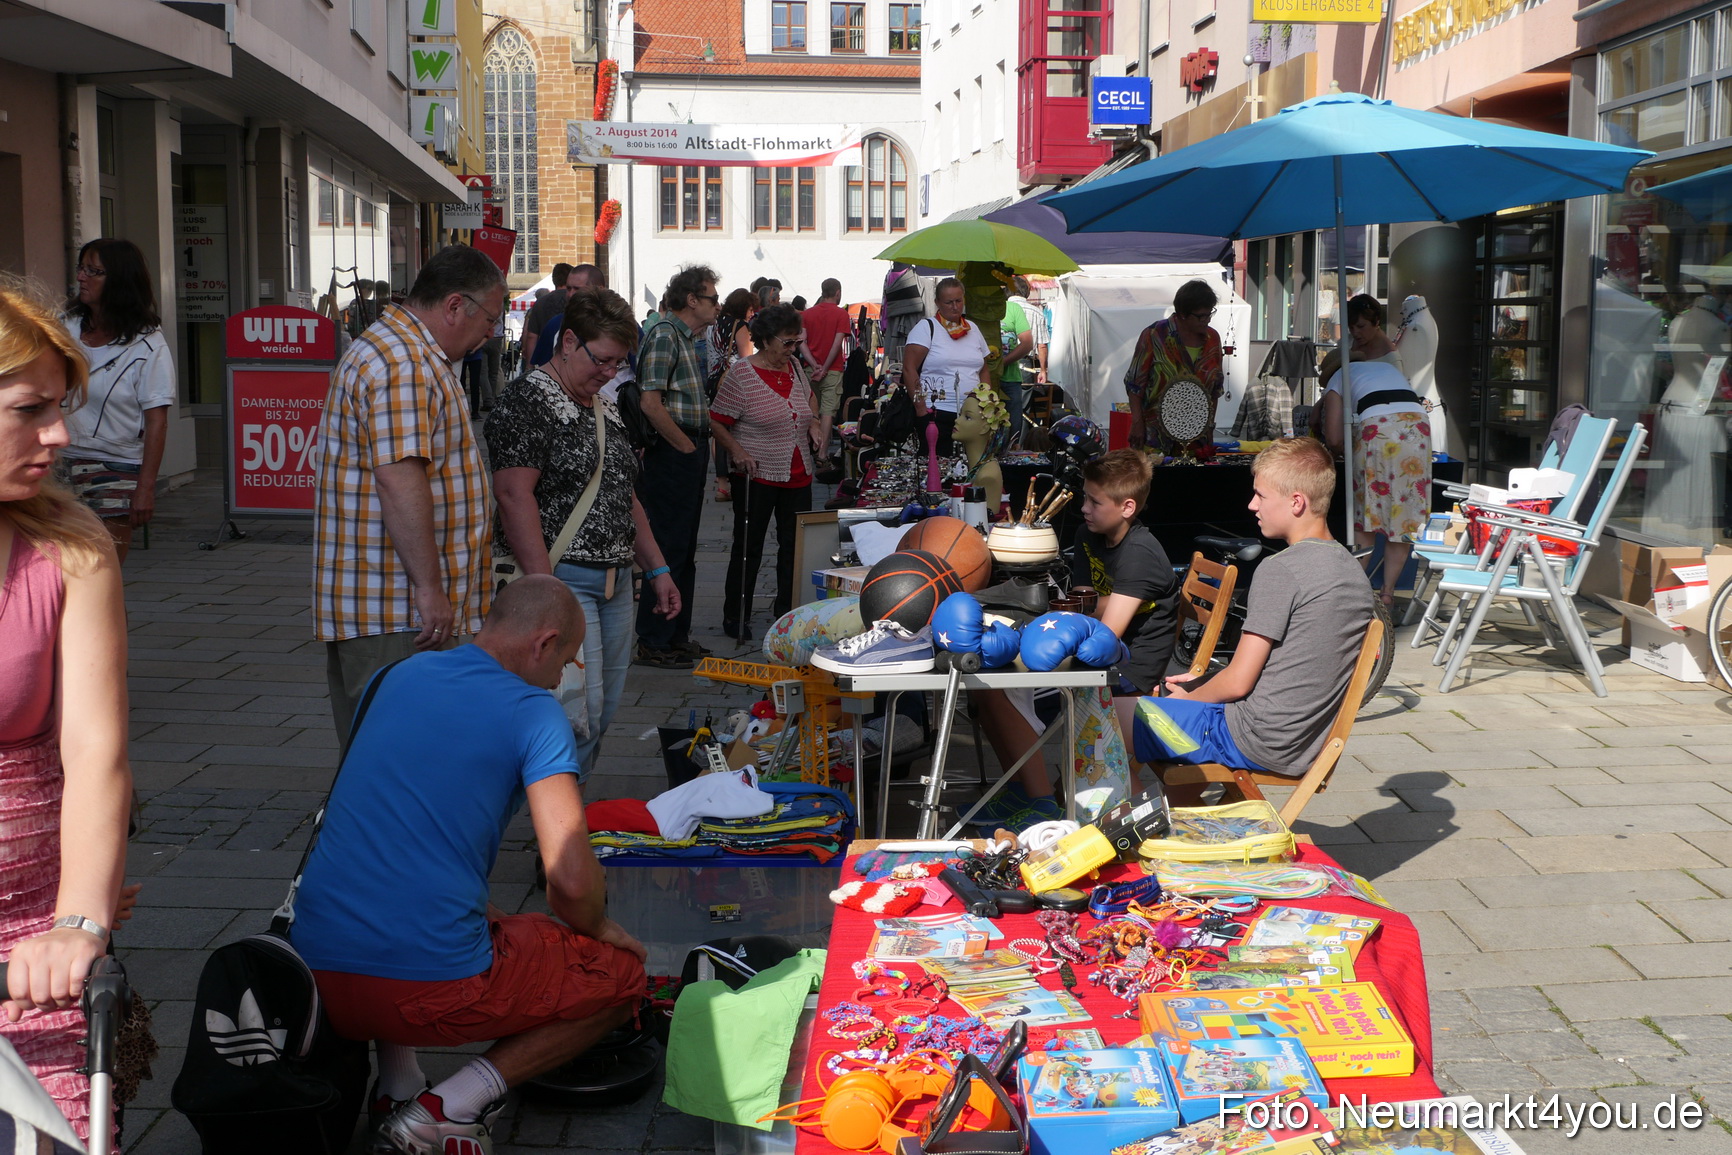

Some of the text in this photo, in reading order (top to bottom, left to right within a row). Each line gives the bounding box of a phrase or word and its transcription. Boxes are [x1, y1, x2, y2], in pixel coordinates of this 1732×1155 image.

[1261, 0, 1361, 11] KLOSTERGASSE
[1098, 91, 1145, 105] CECIL
[595, 127, 677, 139] 2. August 2014
[684, 135, 832, 150] Altstadt-Flohmarkt
[445, 202, 480, 212] SARAH K
[186, 237, 213, 245] noch
[202, 281, 227, 289] 70%
[243, 317, 319, 343] WITT
[262, 345, 302, 353] weiden
[241, 398, 324, 409] DAMEN-MODE
[265, 410, 300, 420] BIS ZU
[242, 424, 317, 472] 50%
[243, 474, 316, 488] REDUZIER
[1315, 994, 1345, 1015] noch
[1340, 992, 1383, 1035] Was passt
[1350, 1052, 1373, 1061] noch
[1377, 1050, 1401, 1060] rein?
[1134, 1051, 1160, 1084] playmobil
